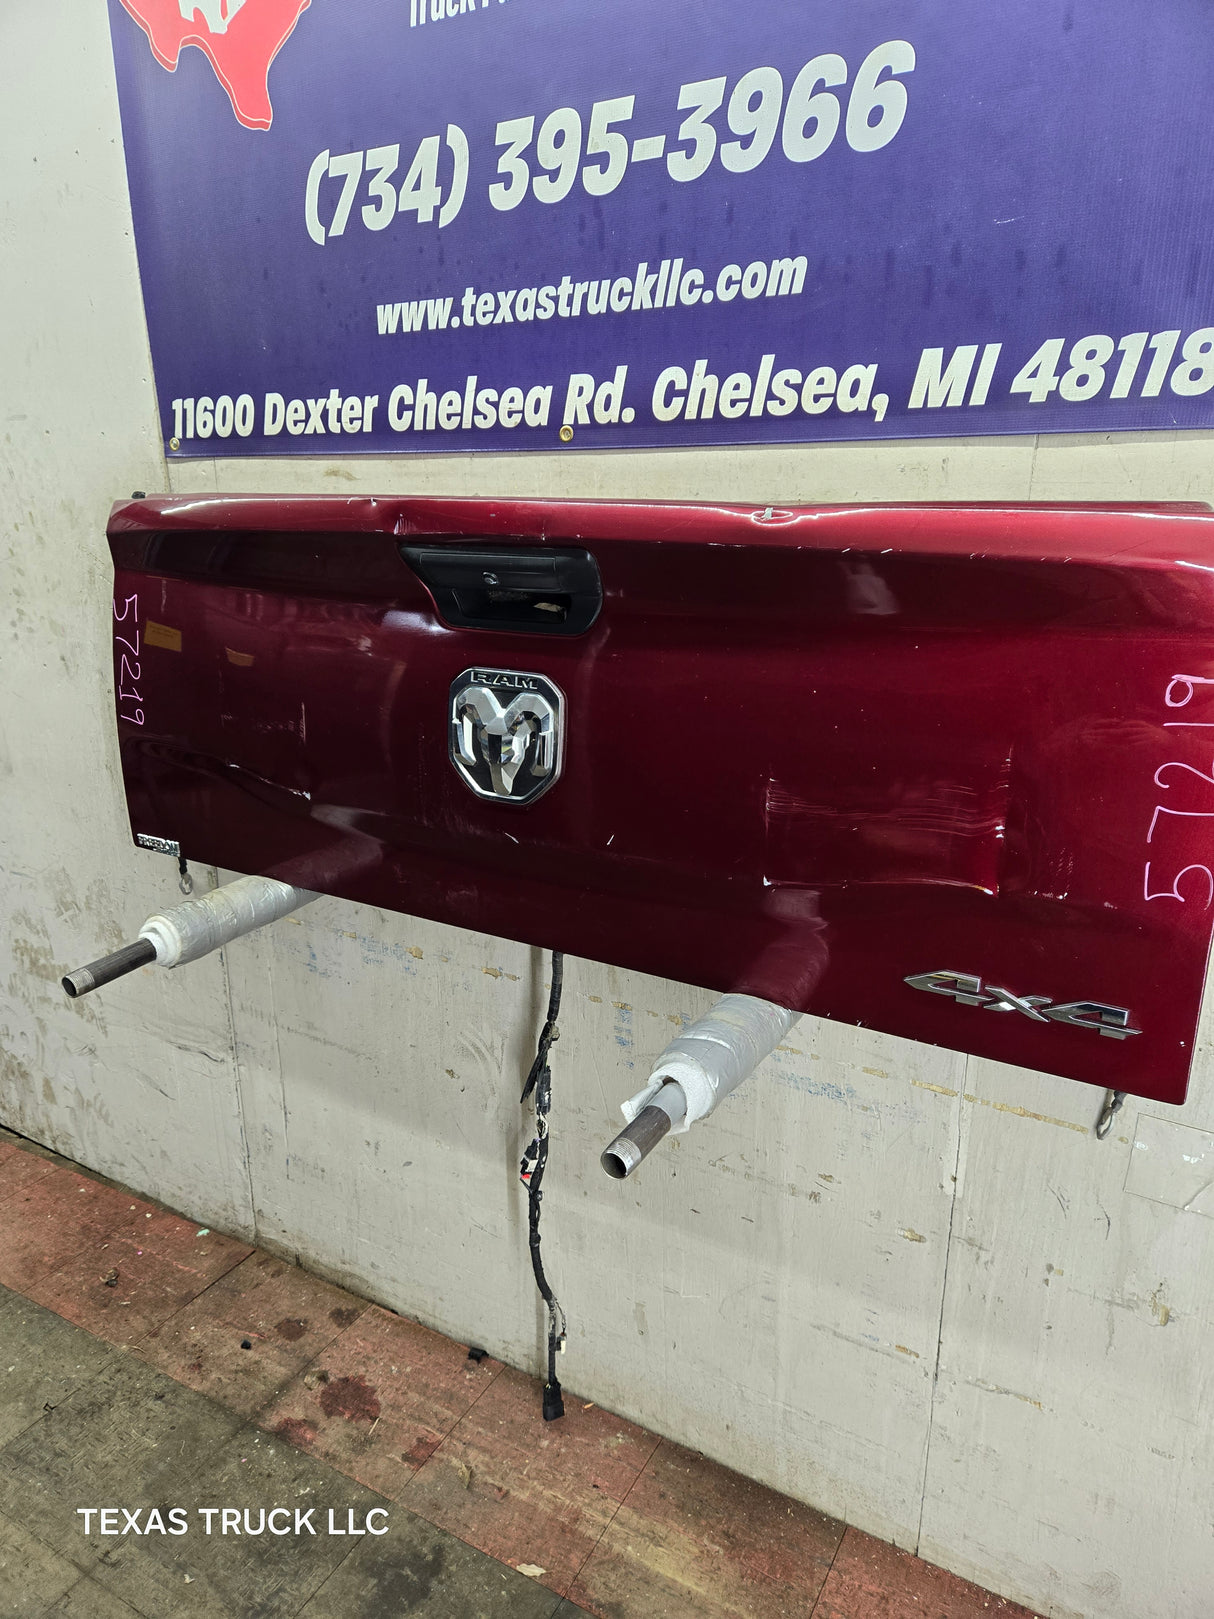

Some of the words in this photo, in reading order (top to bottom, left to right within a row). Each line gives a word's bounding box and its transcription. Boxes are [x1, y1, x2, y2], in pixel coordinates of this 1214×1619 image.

[305, 124, 469, 245] (734)
[488, 40, 916, 211] 395-3966
[377, 255, 807, 335] www.texastruckllc.com
[171, 393, 254, 438] 11600
[263, 388, 379, 436] Dexter
[388, 375, 553, 431] Chelsea
[563, 365, 635, 425] Rd.
[652, 354, 889, 422] Chelsea,
[907, 342, 1002, 409] MI
[1010, 327, 1214, 403] 48118
[113, 594, 144, 725] 57219
[470, 671, 538, 690] RAM
